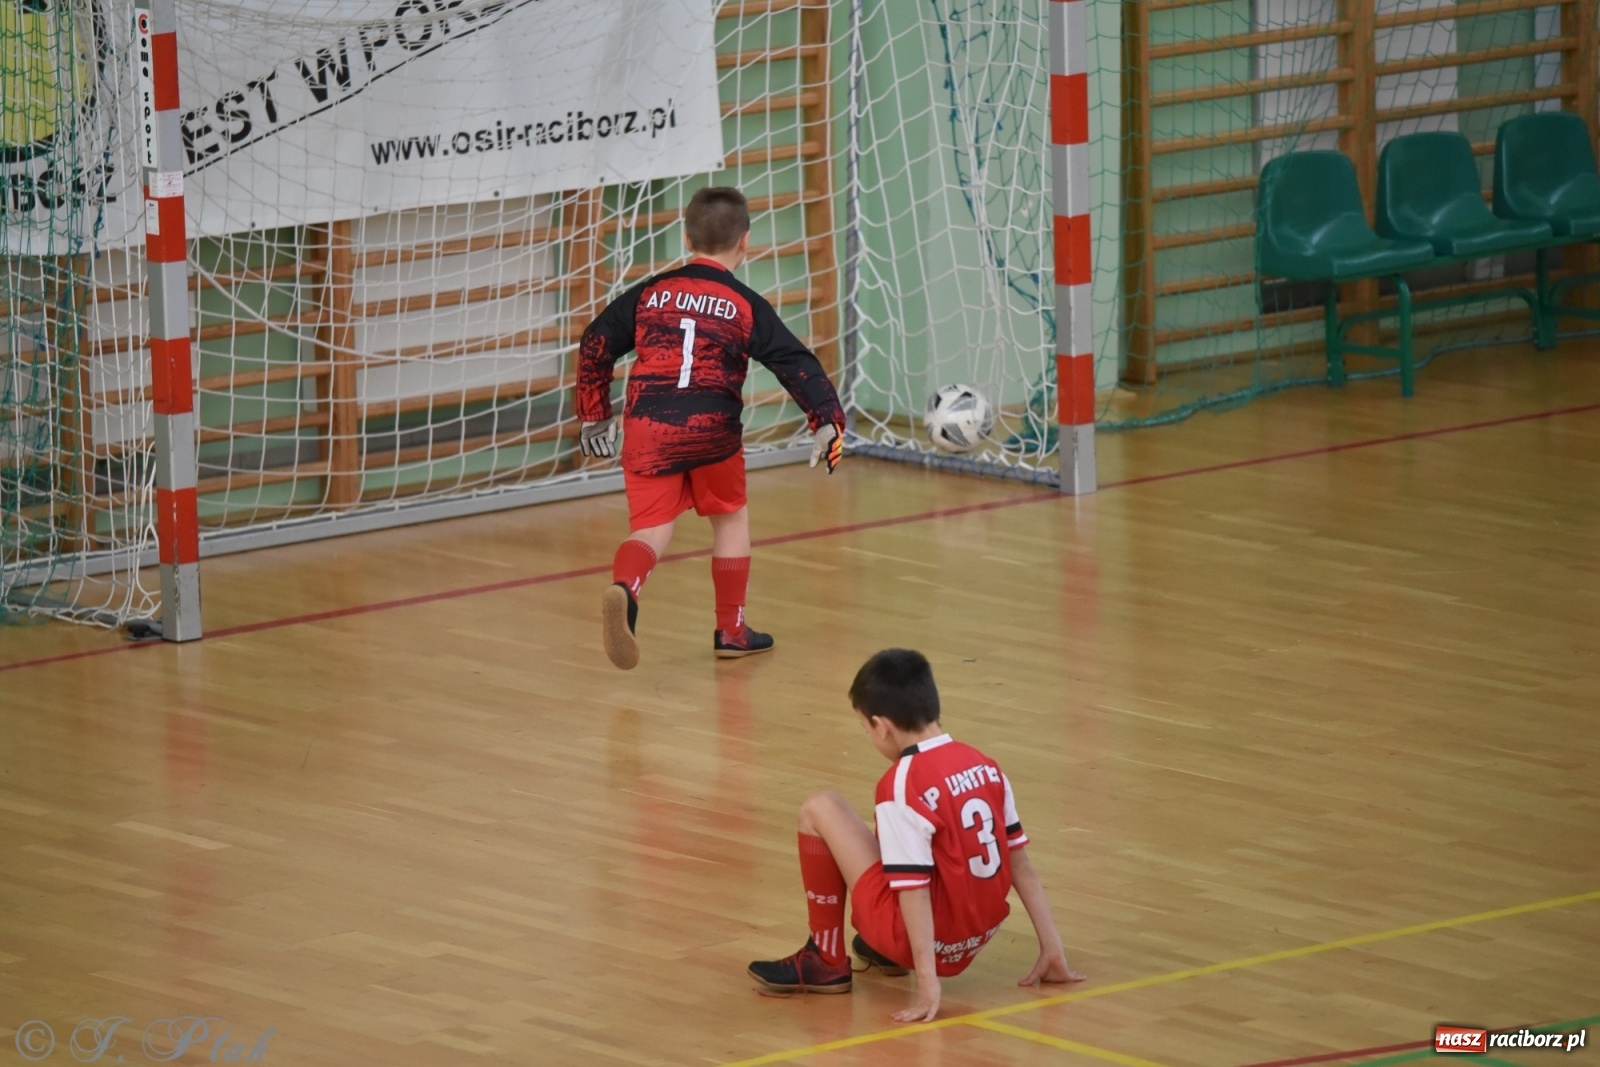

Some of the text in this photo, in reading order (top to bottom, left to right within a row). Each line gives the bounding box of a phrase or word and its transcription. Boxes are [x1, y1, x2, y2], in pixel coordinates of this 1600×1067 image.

[179, 69, 279, 165] EST
[370, 98, 677, 166] www.osir-raciborz.pl
[646, 290, 737, 320] AP UNITED
[677, 317, 697, 389] 1
[918, 764, 1001, 812] P UNITE
[961, 797, 1001, 878] 3
